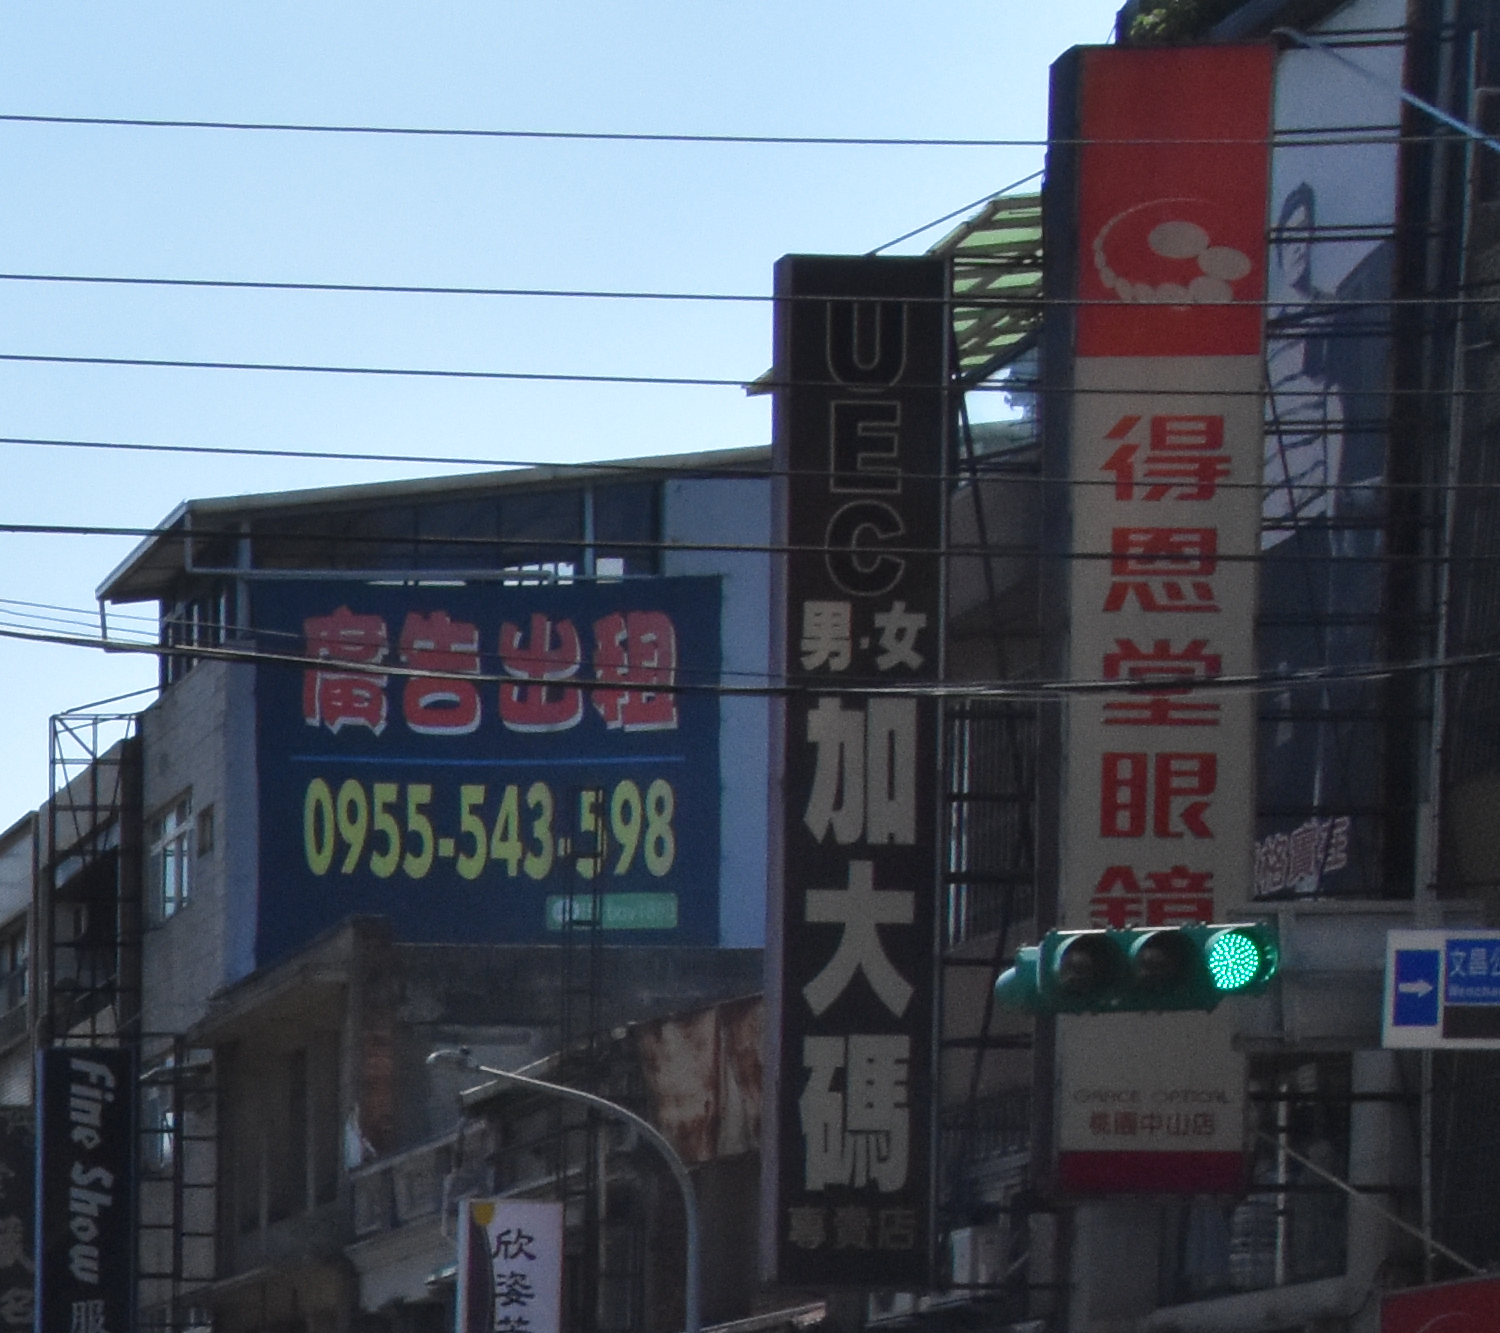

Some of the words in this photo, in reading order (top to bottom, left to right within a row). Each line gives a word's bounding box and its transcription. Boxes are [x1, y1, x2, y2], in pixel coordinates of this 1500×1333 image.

[301, 604, 680, 737] 廣告出租
[798, 695, 918, 1193] 加大碼
[788, 1204, 917, 1251] 專賣店
